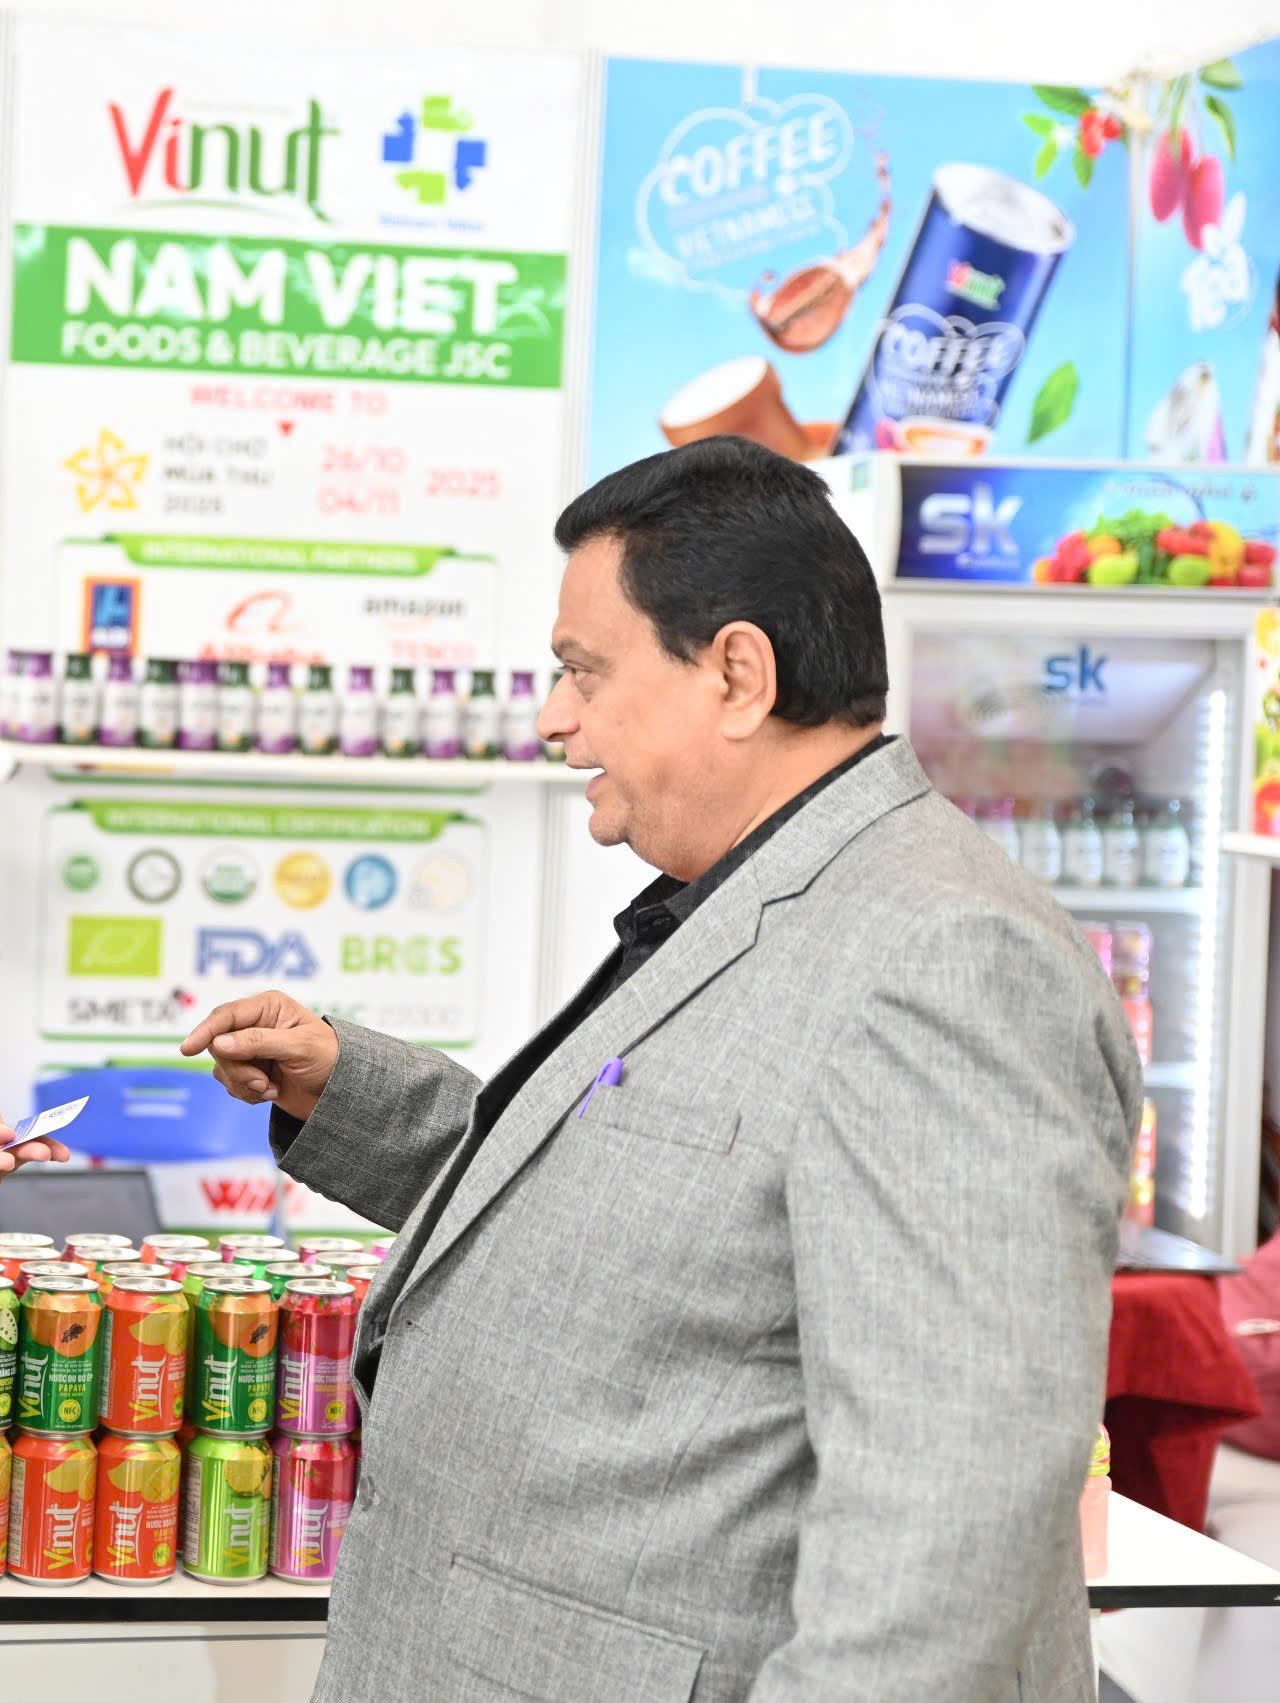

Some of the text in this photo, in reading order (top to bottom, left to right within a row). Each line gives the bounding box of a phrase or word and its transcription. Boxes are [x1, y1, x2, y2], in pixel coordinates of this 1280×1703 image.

[107, 87, 341, 226] Vinut
[661, 109, 837, 205] COFFEE
[65, 237, 519, 337] NAM VIET
[61, 320, 513, 381] FOODS & BEVERAGE JSC
[190, 385, 388, 415] WELCOME TO
[196, 927, 320, 979] FDA
[18, 1351, 49, 1417] Vinut
[59, 1384, 86, 1392] PAPAYA
[64, 1407, 76, 1415] NFC
[129, 1354, 167, 1421] Vinut
[202, 1354, 238, 1421] Vinut
[280, 1354, 310, 1419] Vinut
[43, 1501, 80, 1570] Vinut
[107, 1501, 144, 1567] Vinut
[222, 1502, 257, 1568] Vinut
